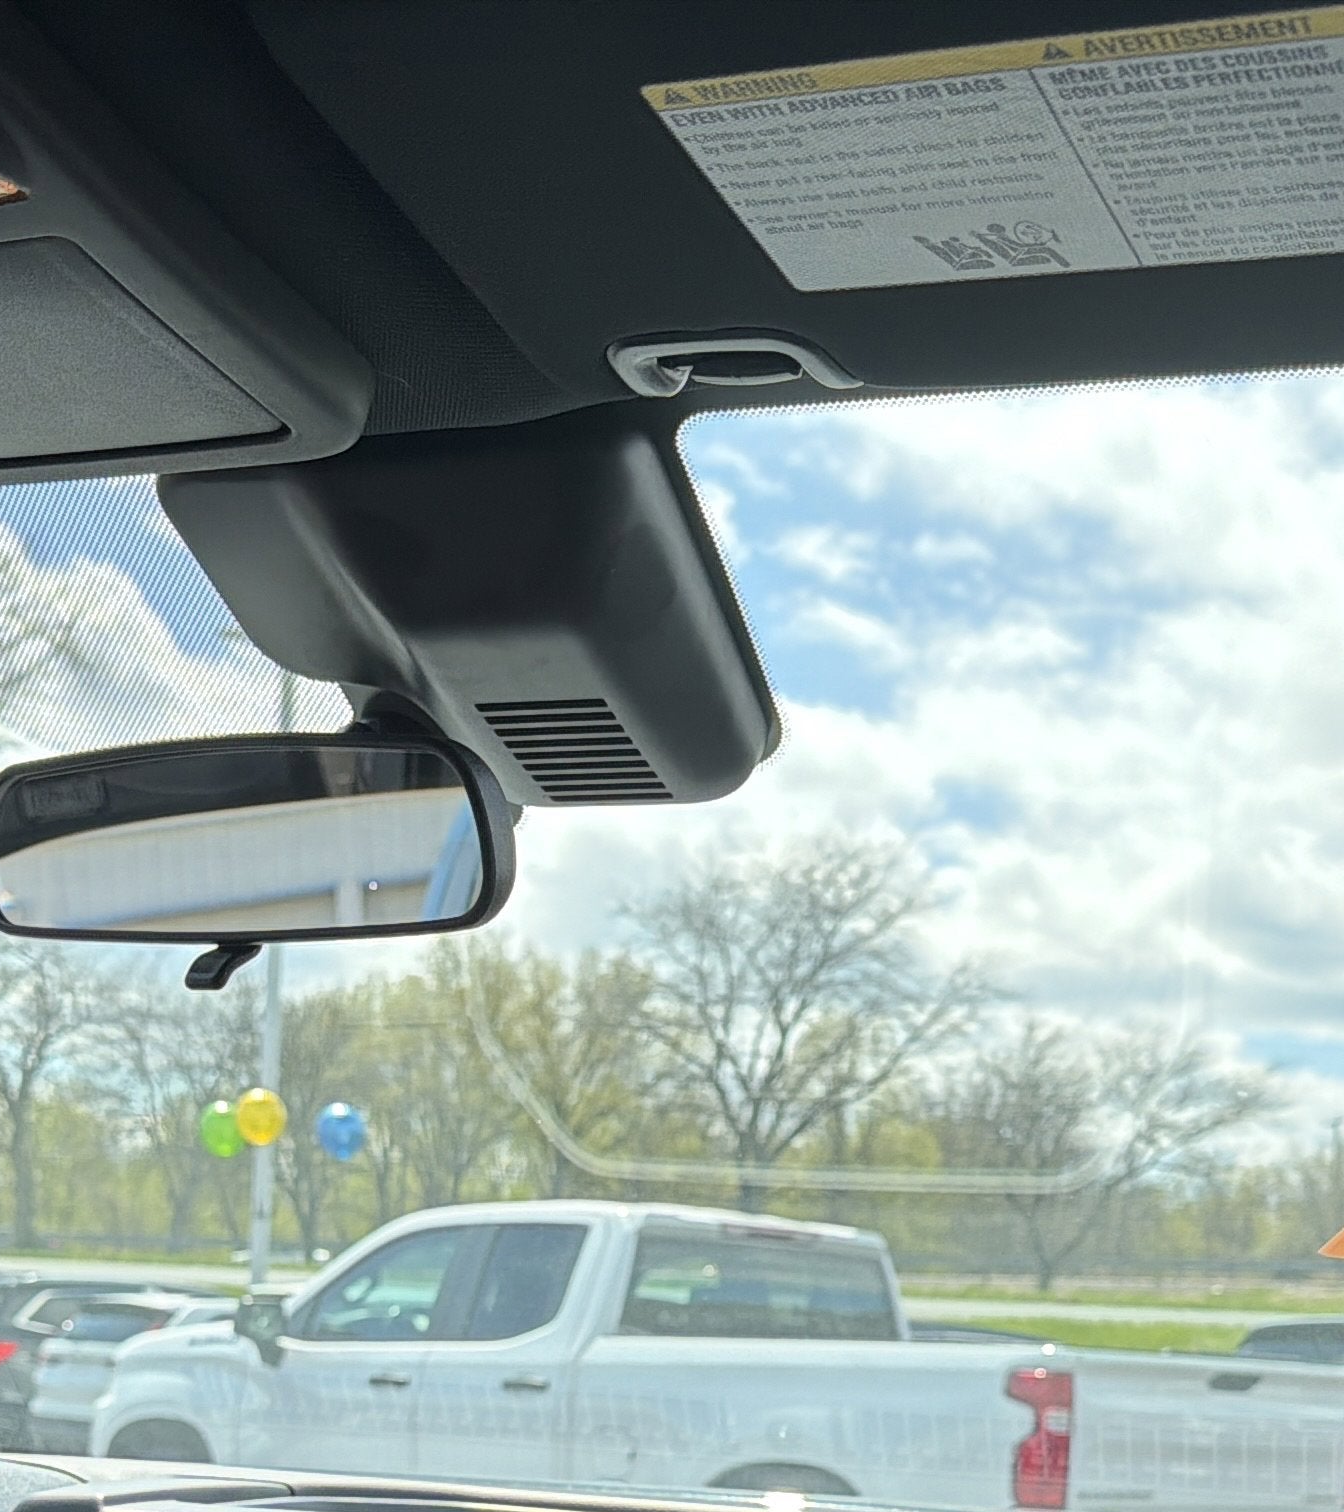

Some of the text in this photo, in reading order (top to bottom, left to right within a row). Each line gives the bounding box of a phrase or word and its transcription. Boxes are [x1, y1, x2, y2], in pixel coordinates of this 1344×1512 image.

[1083, 16, 1311, 57] AVERTISSEMENT
[669, 78, 1007, 127] EVEN WITH ADVANCED AIR BAGS
[691, 72, 821, 100] WARNING
